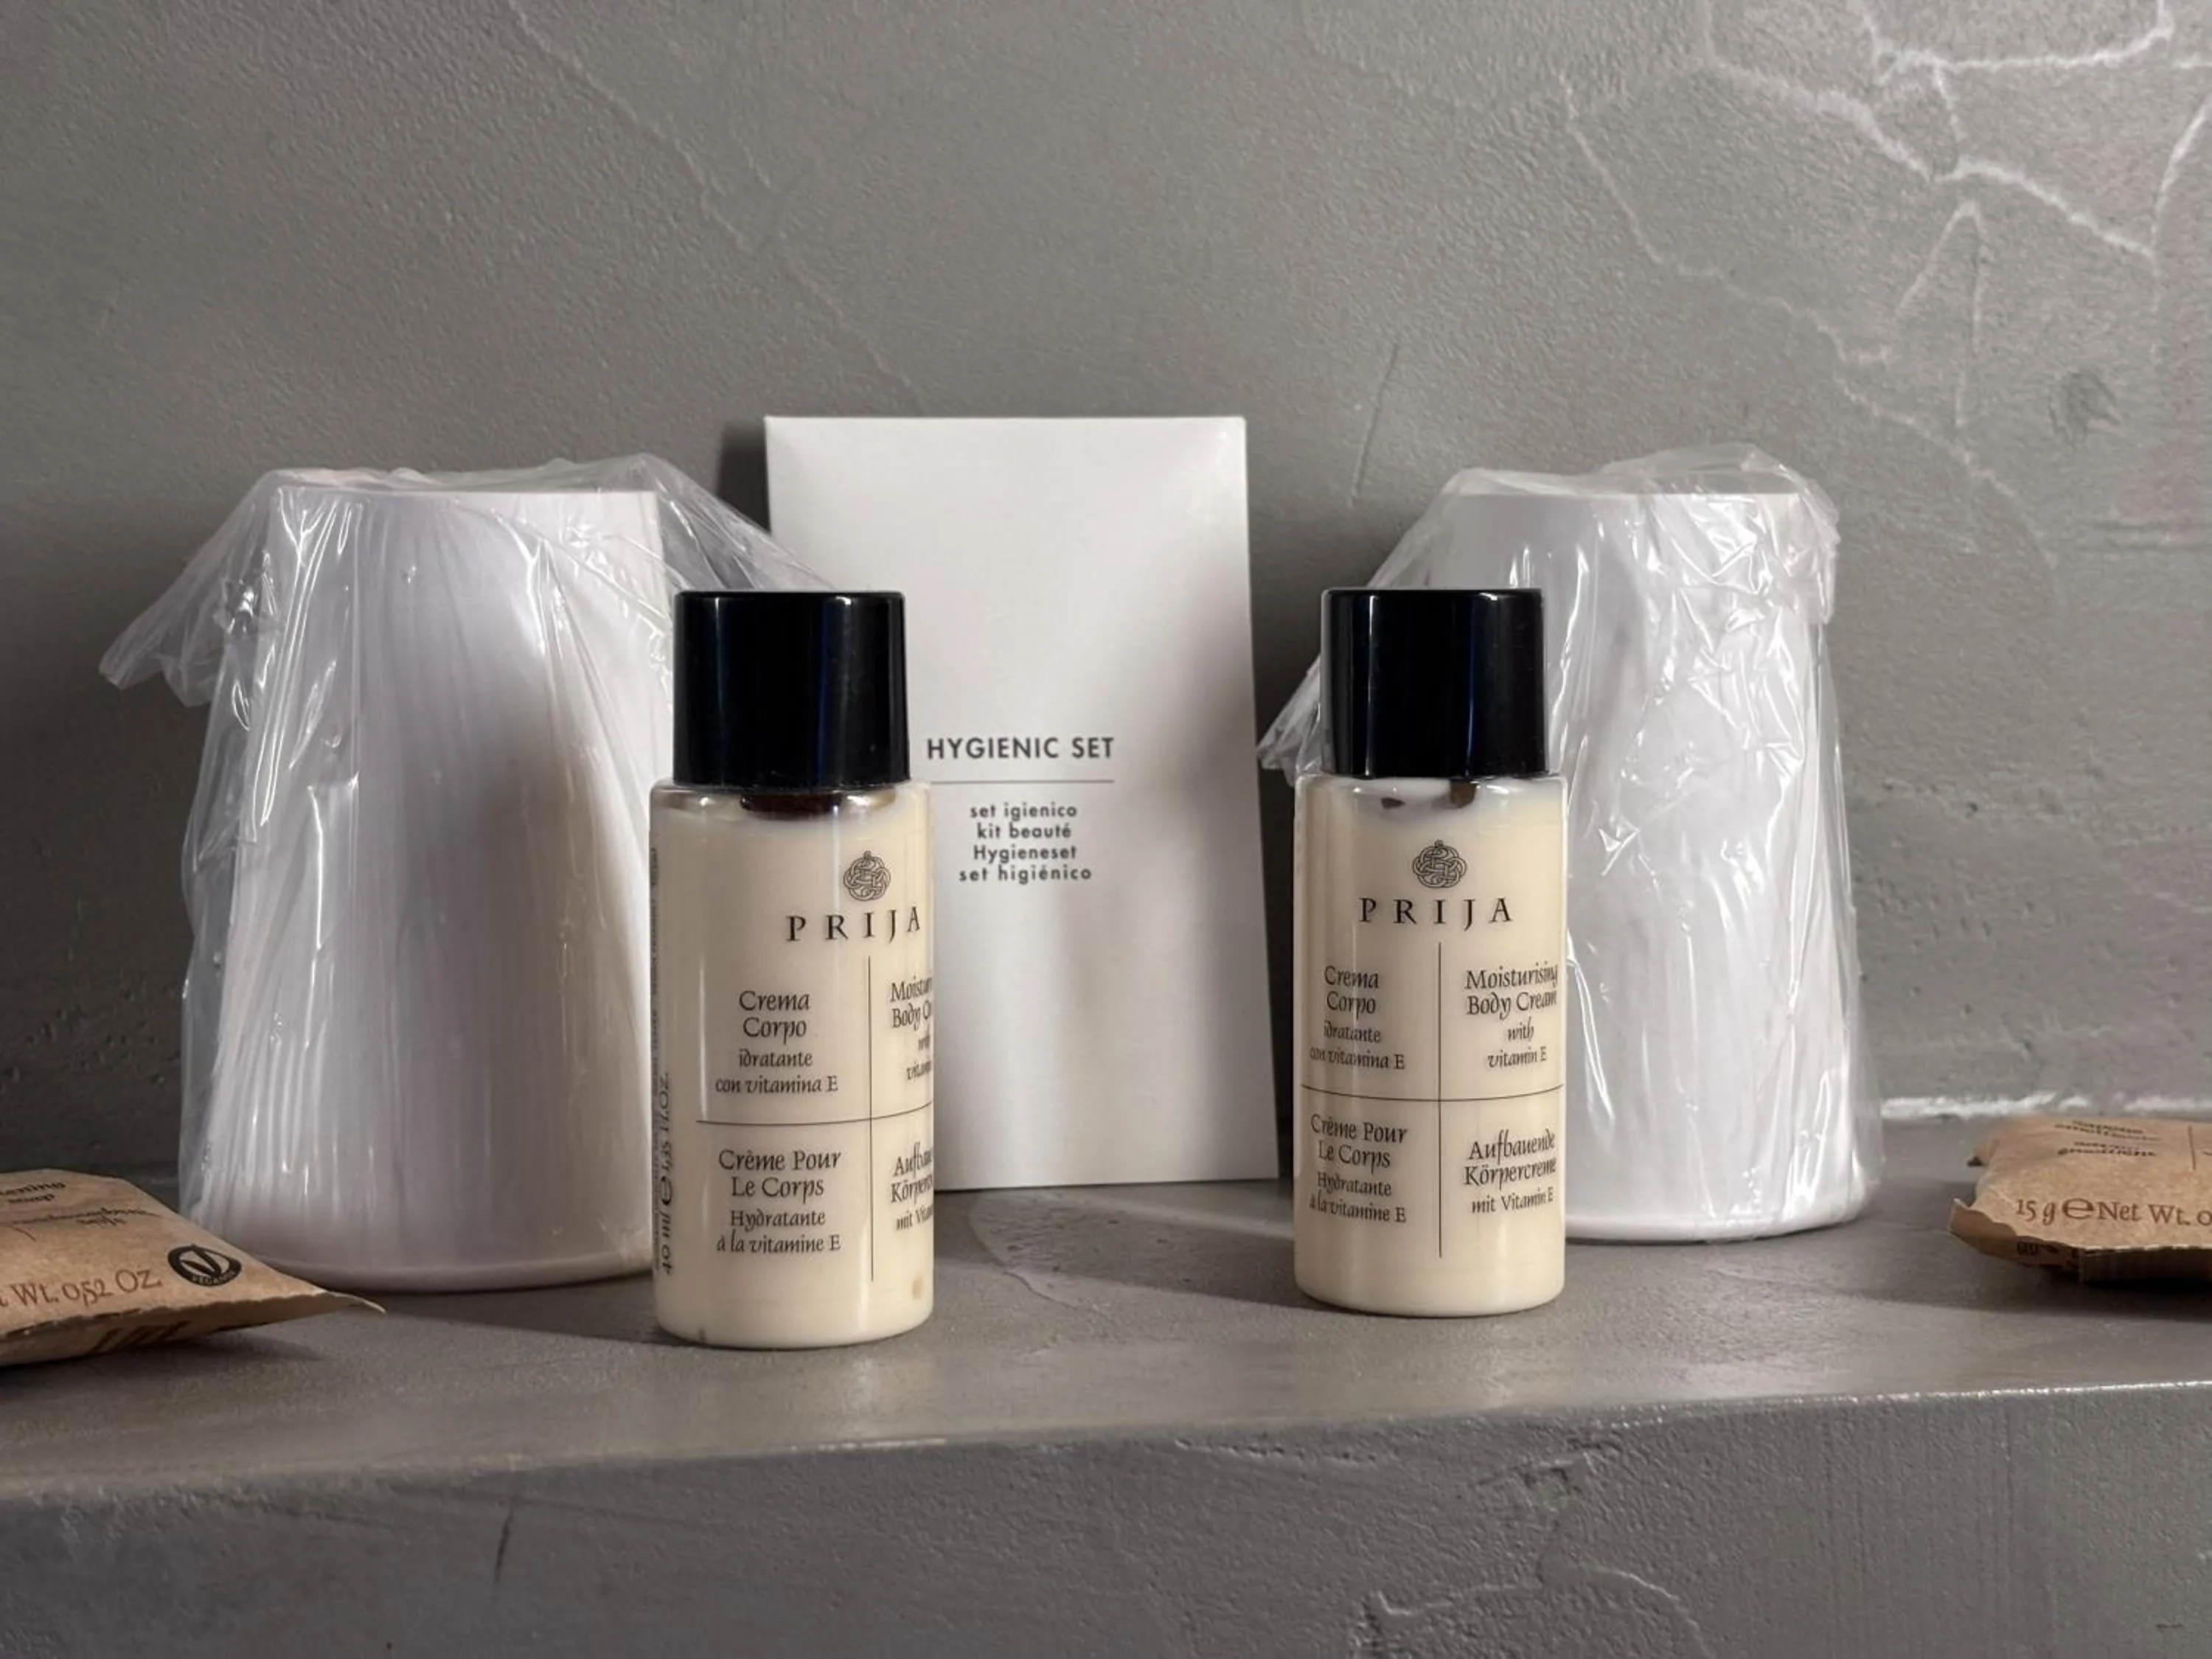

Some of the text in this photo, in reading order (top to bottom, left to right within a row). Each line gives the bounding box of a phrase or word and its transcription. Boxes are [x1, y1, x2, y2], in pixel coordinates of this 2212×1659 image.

[927, 737, 1115, 759] HYGIENIC SET
[970, 802, 1078, 822] set igienico
[977, 822, 1072, 839] kit beauté
[973, 844, 1077, 864] Hygieneset
[959, 864, 1093, 885] set higiénico
[785, 906, 921, 943] PRIJA
[1359, 897, 1514, 931] PRIJA
[1324, 965, 1380, 989] Crema
[1464, 961, 1558, 990] Moisturising
[739, 990, 811, 1011] Crema
[1326, 991, 1377, 1020] Corpo
[1467, 990, 1557, 1020] Body Cream
[891, 1003, 921, 1032] Body
[1507, 1016, 1535, 1041] with
[743, 1017, 807, 1045] Corpo
[739, 1048, 813, 1068] idratante
[1328, 1046, 1389, 1069] vitamina
[1394, 1054, 1405, 1070] E
[1488, 1046, 1547, 1068] vitamin E
[715, 1076, 838, 1095] con vitamina E
[1310, 1113, 1408, 1144] Crème Pour
[1318, 1140, 1391, 1175] Le Corps
[1467, 1127, 1555, 1166] Aufbauende
[718, 1150, 842, 1171] Crème Pour
[1317, 1171, 1392, 1197] Hydratante
[1463, 1157, 1557, 1191] Körpercreme
[730, 1176, 825, 1203] Le Corps
[1472, 1186, 1554, 1214] mit Vitamin E
[1318, 1189, 1327, 1213] la
[1329, 1198, 1391, 1222] vitamine
[1395, 1206, 1406, 1222] E
[2015, 1198, 2037, 1222] 15
[2042, 1201, 2056, 1226] g
[2096, 1201, 2141, 1222] Net
[2146, 1203, 2191, 1226] Wt.
[730, 1208, 827, 1231] Hydratante
[896, 1209, 914, 1231] mit
[731, 1227, 745, 1253] la
[749, 1233, 825, 1254] vitamine
[830, 1234, 842, 1252] E
[10, 1282, 59, 1306] Wt.
